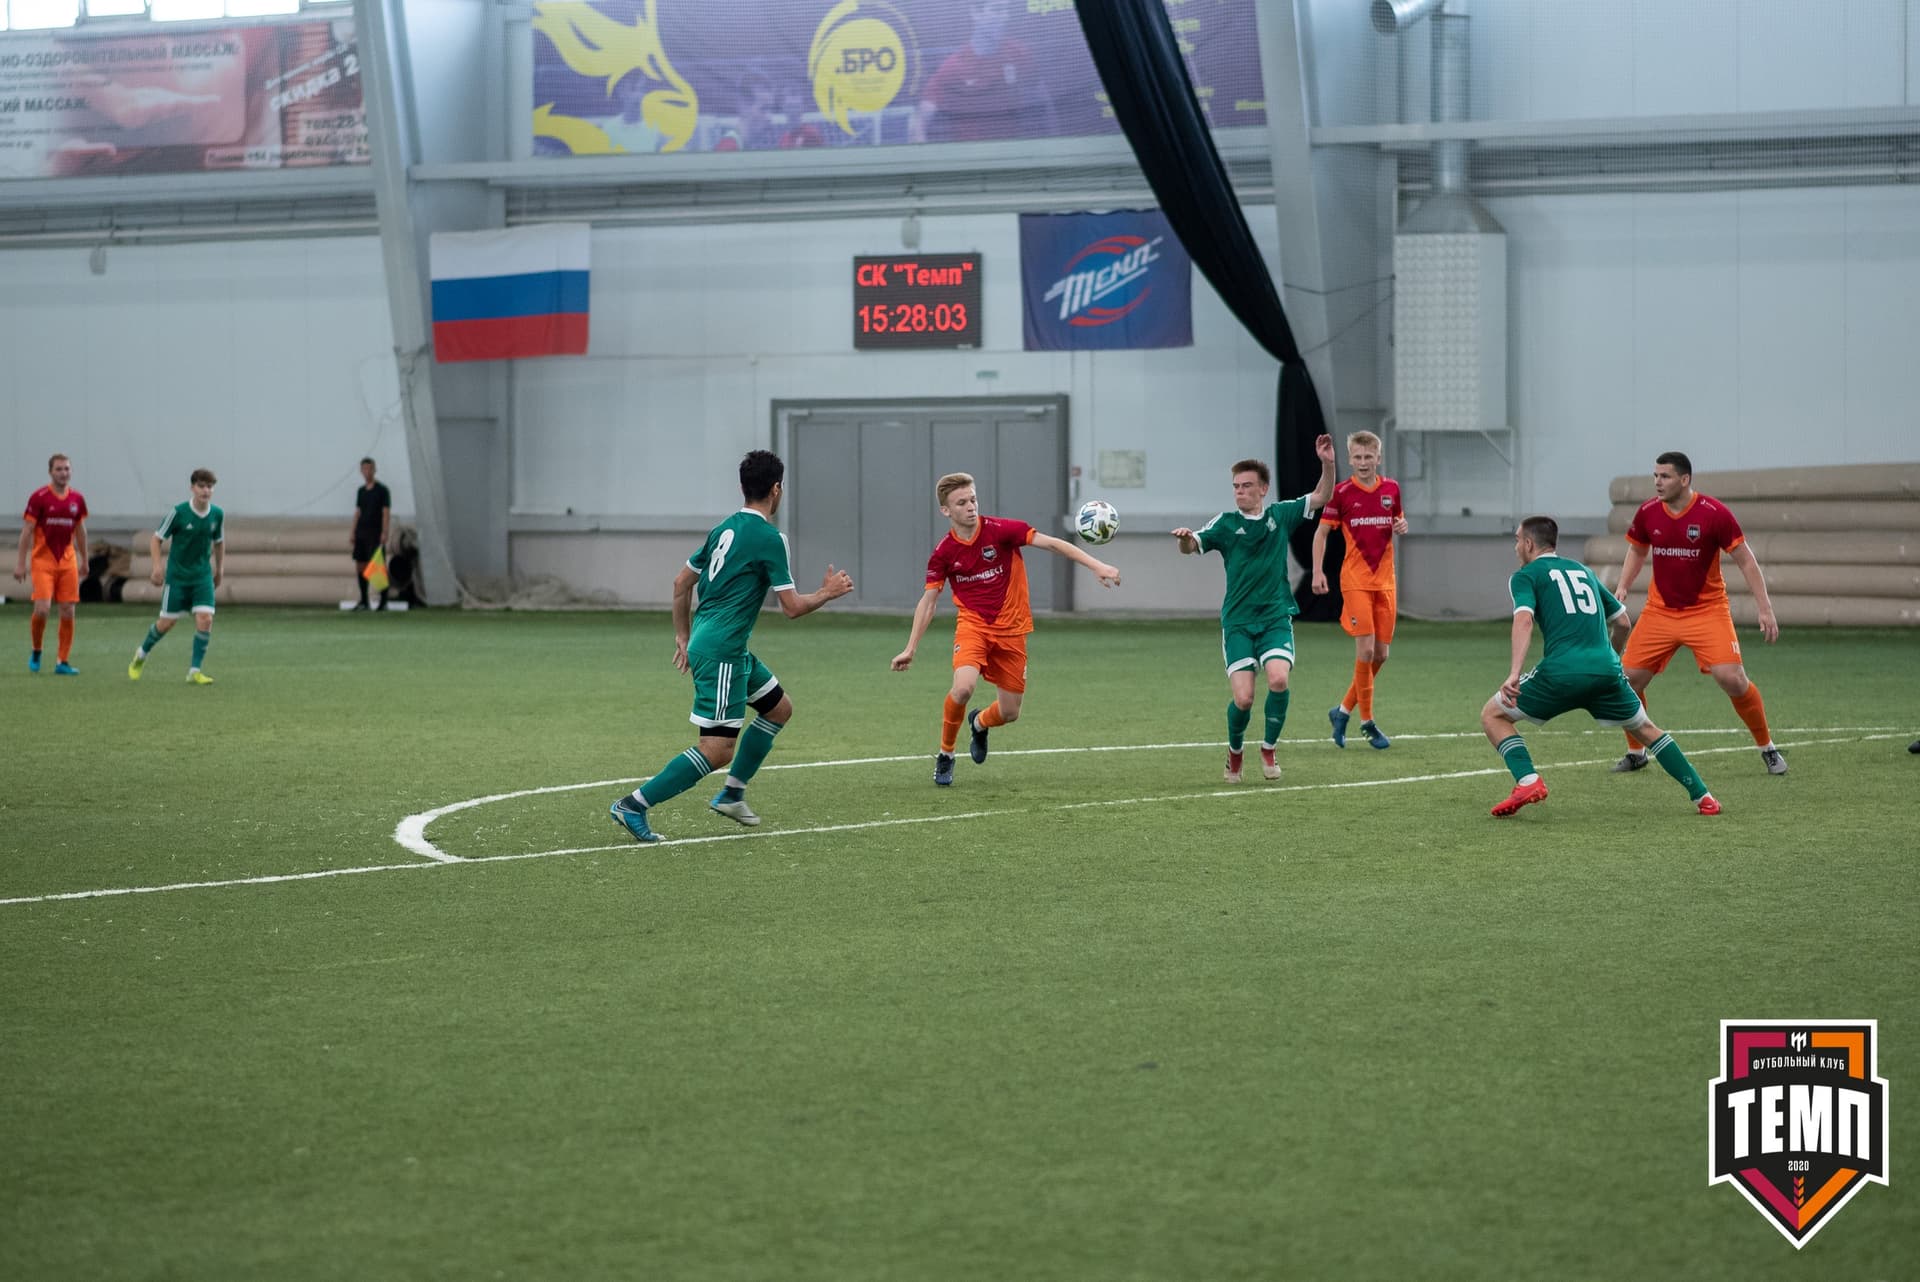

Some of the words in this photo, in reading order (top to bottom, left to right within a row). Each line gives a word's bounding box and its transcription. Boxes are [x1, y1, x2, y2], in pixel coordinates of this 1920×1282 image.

[857, 263, 888, 287] СК
[892, 262, 974, 287] "Темп"
[858, 303, 968, 333] 15:28:03
[708, 528, 735, 582] 8
[1548, 568, 1598, 615] 15
